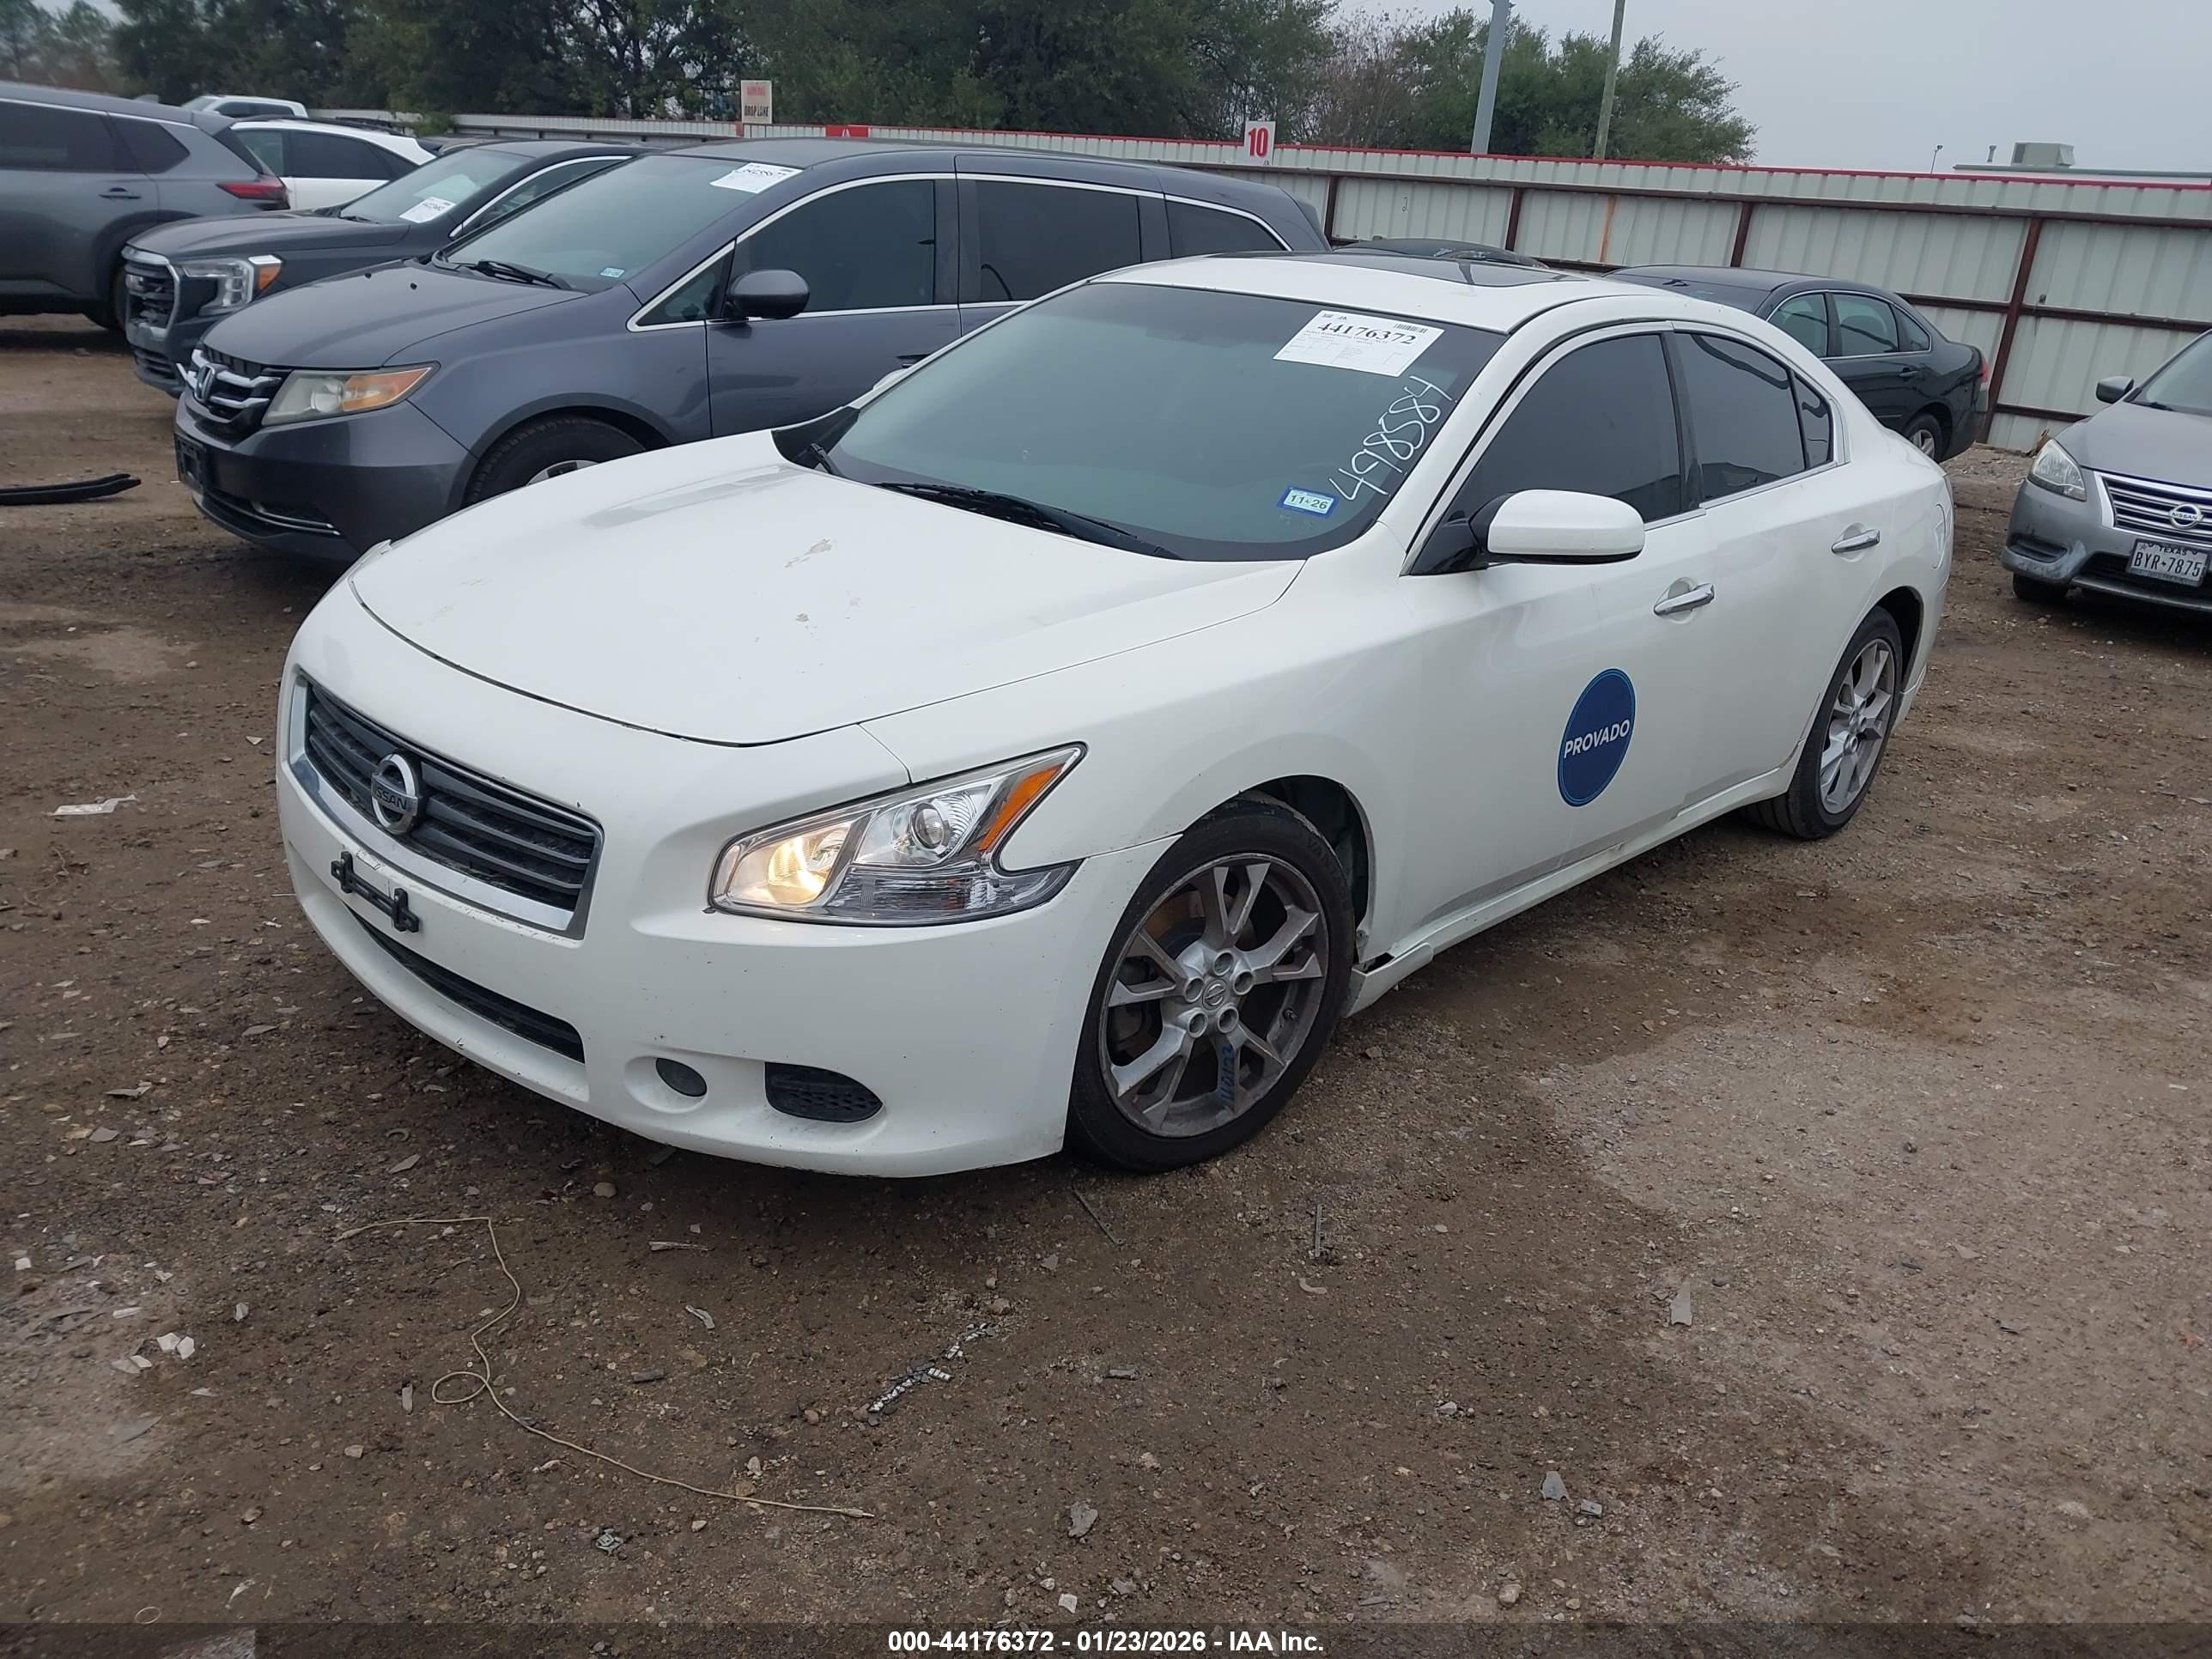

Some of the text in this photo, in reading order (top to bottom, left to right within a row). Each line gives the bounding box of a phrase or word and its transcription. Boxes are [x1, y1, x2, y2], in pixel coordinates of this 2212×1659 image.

[1248, 127, 1268, 157] 10
[1317, 322, 1417, 344] 44176372
[1328, 375, 1453, 501] 498584
[2159, 546, 2187, 556] TEXAS
[1563, 719, 1631, 759] PROVADO
